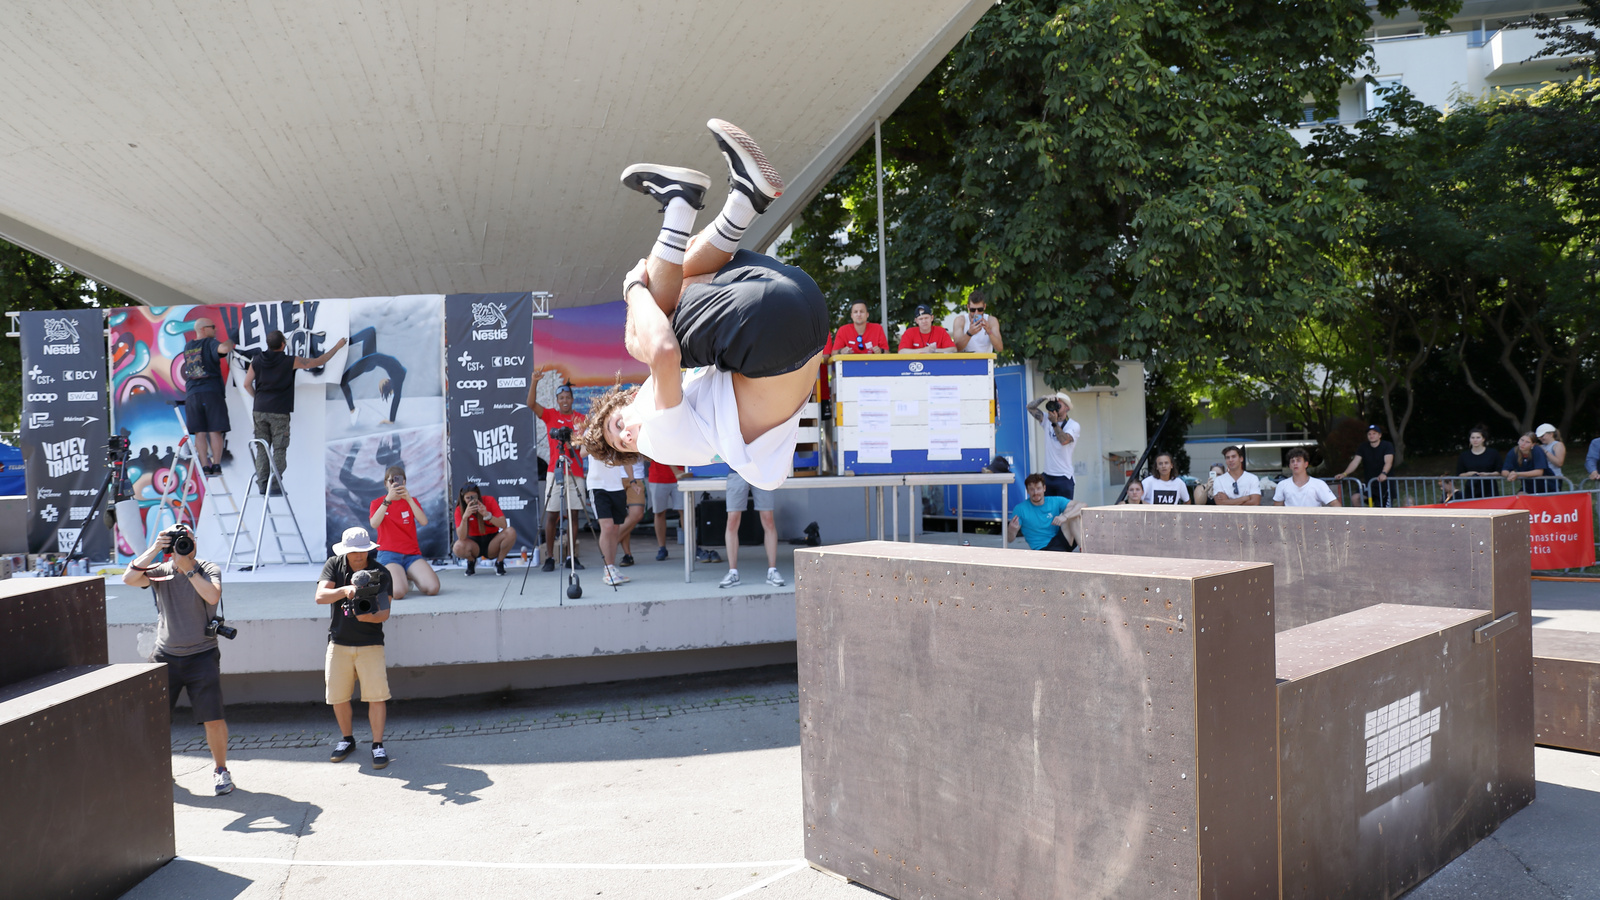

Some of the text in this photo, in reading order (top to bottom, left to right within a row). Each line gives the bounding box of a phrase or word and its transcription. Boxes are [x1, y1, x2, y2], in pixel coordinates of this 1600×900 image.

[472, 329, 508, 341] Nestlé
[43, 343, 80, 355] Nestlé
[503, 356, 525, 366] BCV
[75, 370, 97, 380] BCV
[456, 379, 488, 390] coop
[27, 393, 58, 403] coop
[473, 424, 514, 449] VEVEY
[41, 437, 86, 460] VEVEY
[477, 442, 518, 467] TRACE
[46, 454, 89, 478] TRACE
[497, 478, 518, 486] vevey
